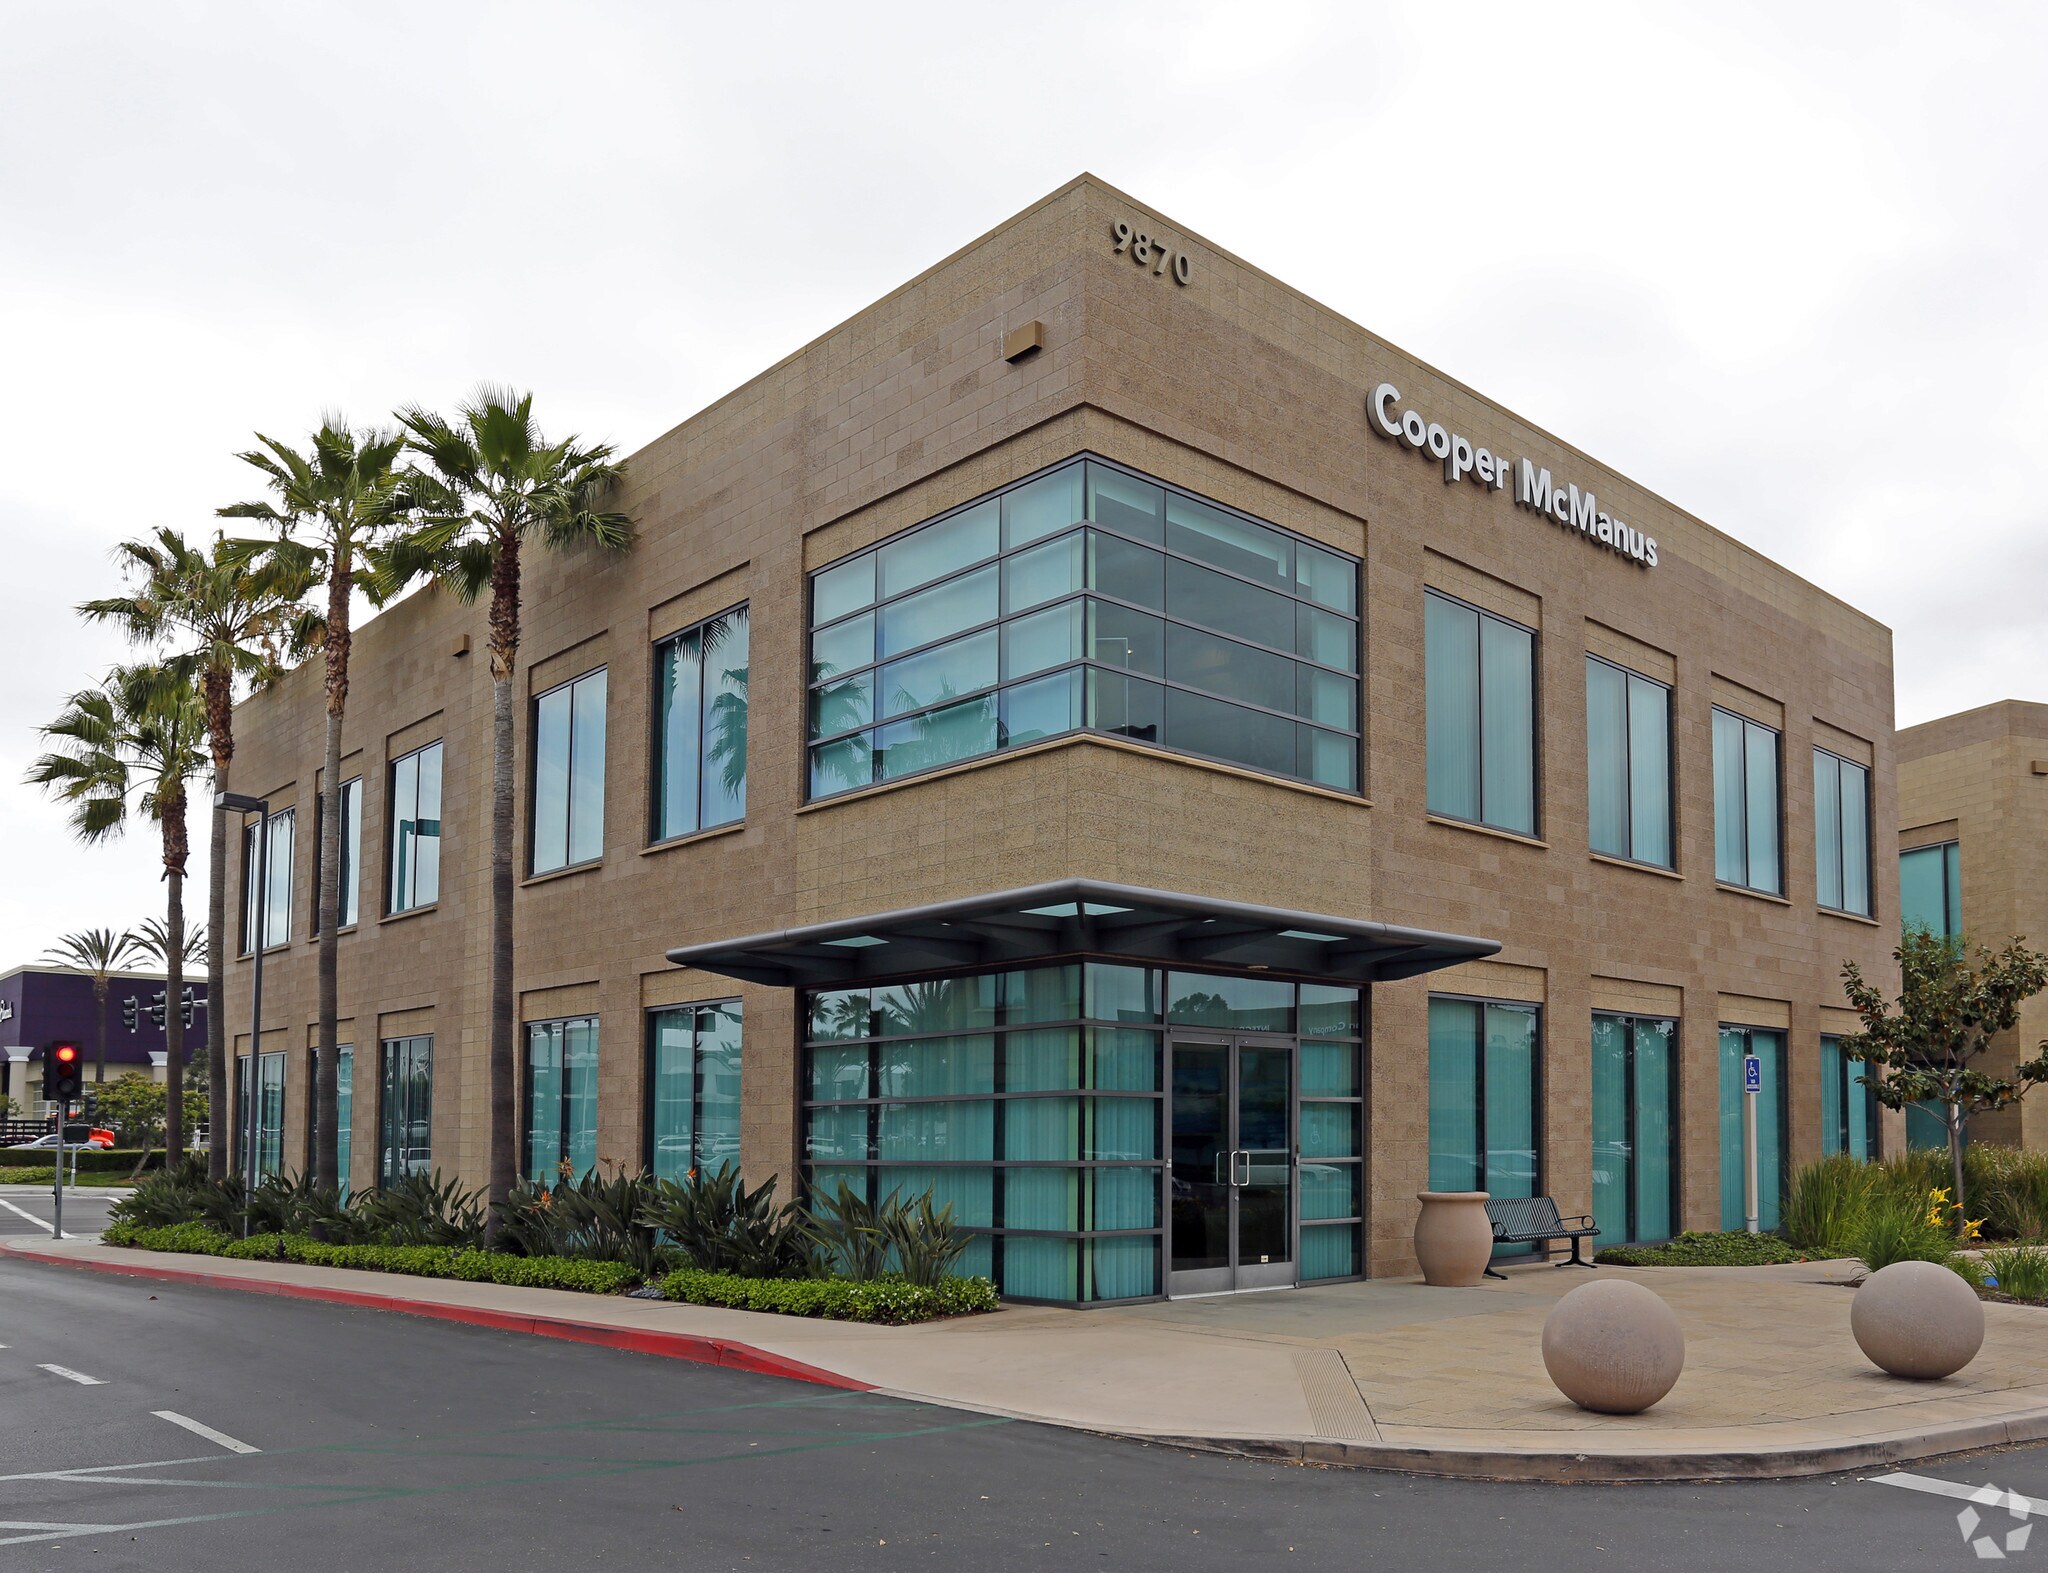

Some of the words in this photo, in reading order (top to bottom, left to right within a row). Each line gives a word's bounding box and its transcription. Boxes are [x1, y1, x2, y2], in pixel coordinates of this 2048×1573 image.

[1112, 218, 1192, 286] 9870
[1368, 383, 1510, 490] Cooper
[1516, 457, 1658, 567] McManus
